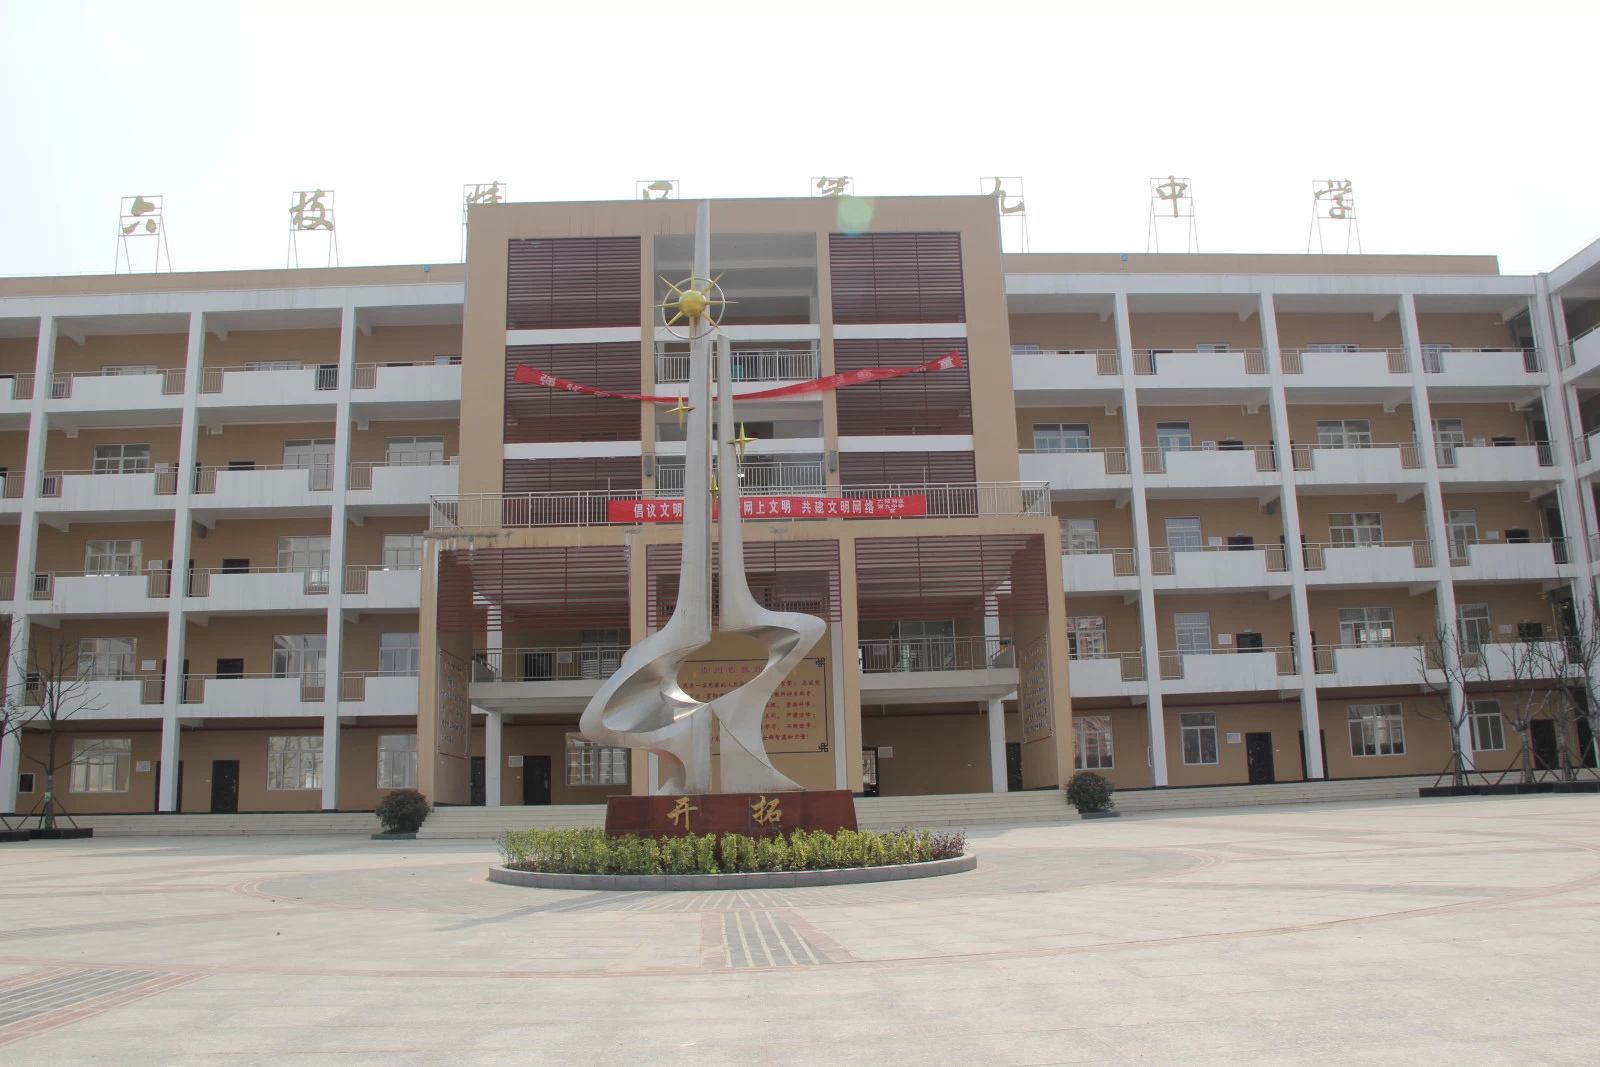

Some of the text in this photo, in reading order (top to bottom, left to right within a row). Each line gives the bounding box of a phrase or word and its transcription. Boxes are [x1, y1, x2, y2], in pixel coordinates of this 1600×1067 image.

[801, 499, 875, 514] 共建文明网络
[666, 795, 783, 831] 开拓
